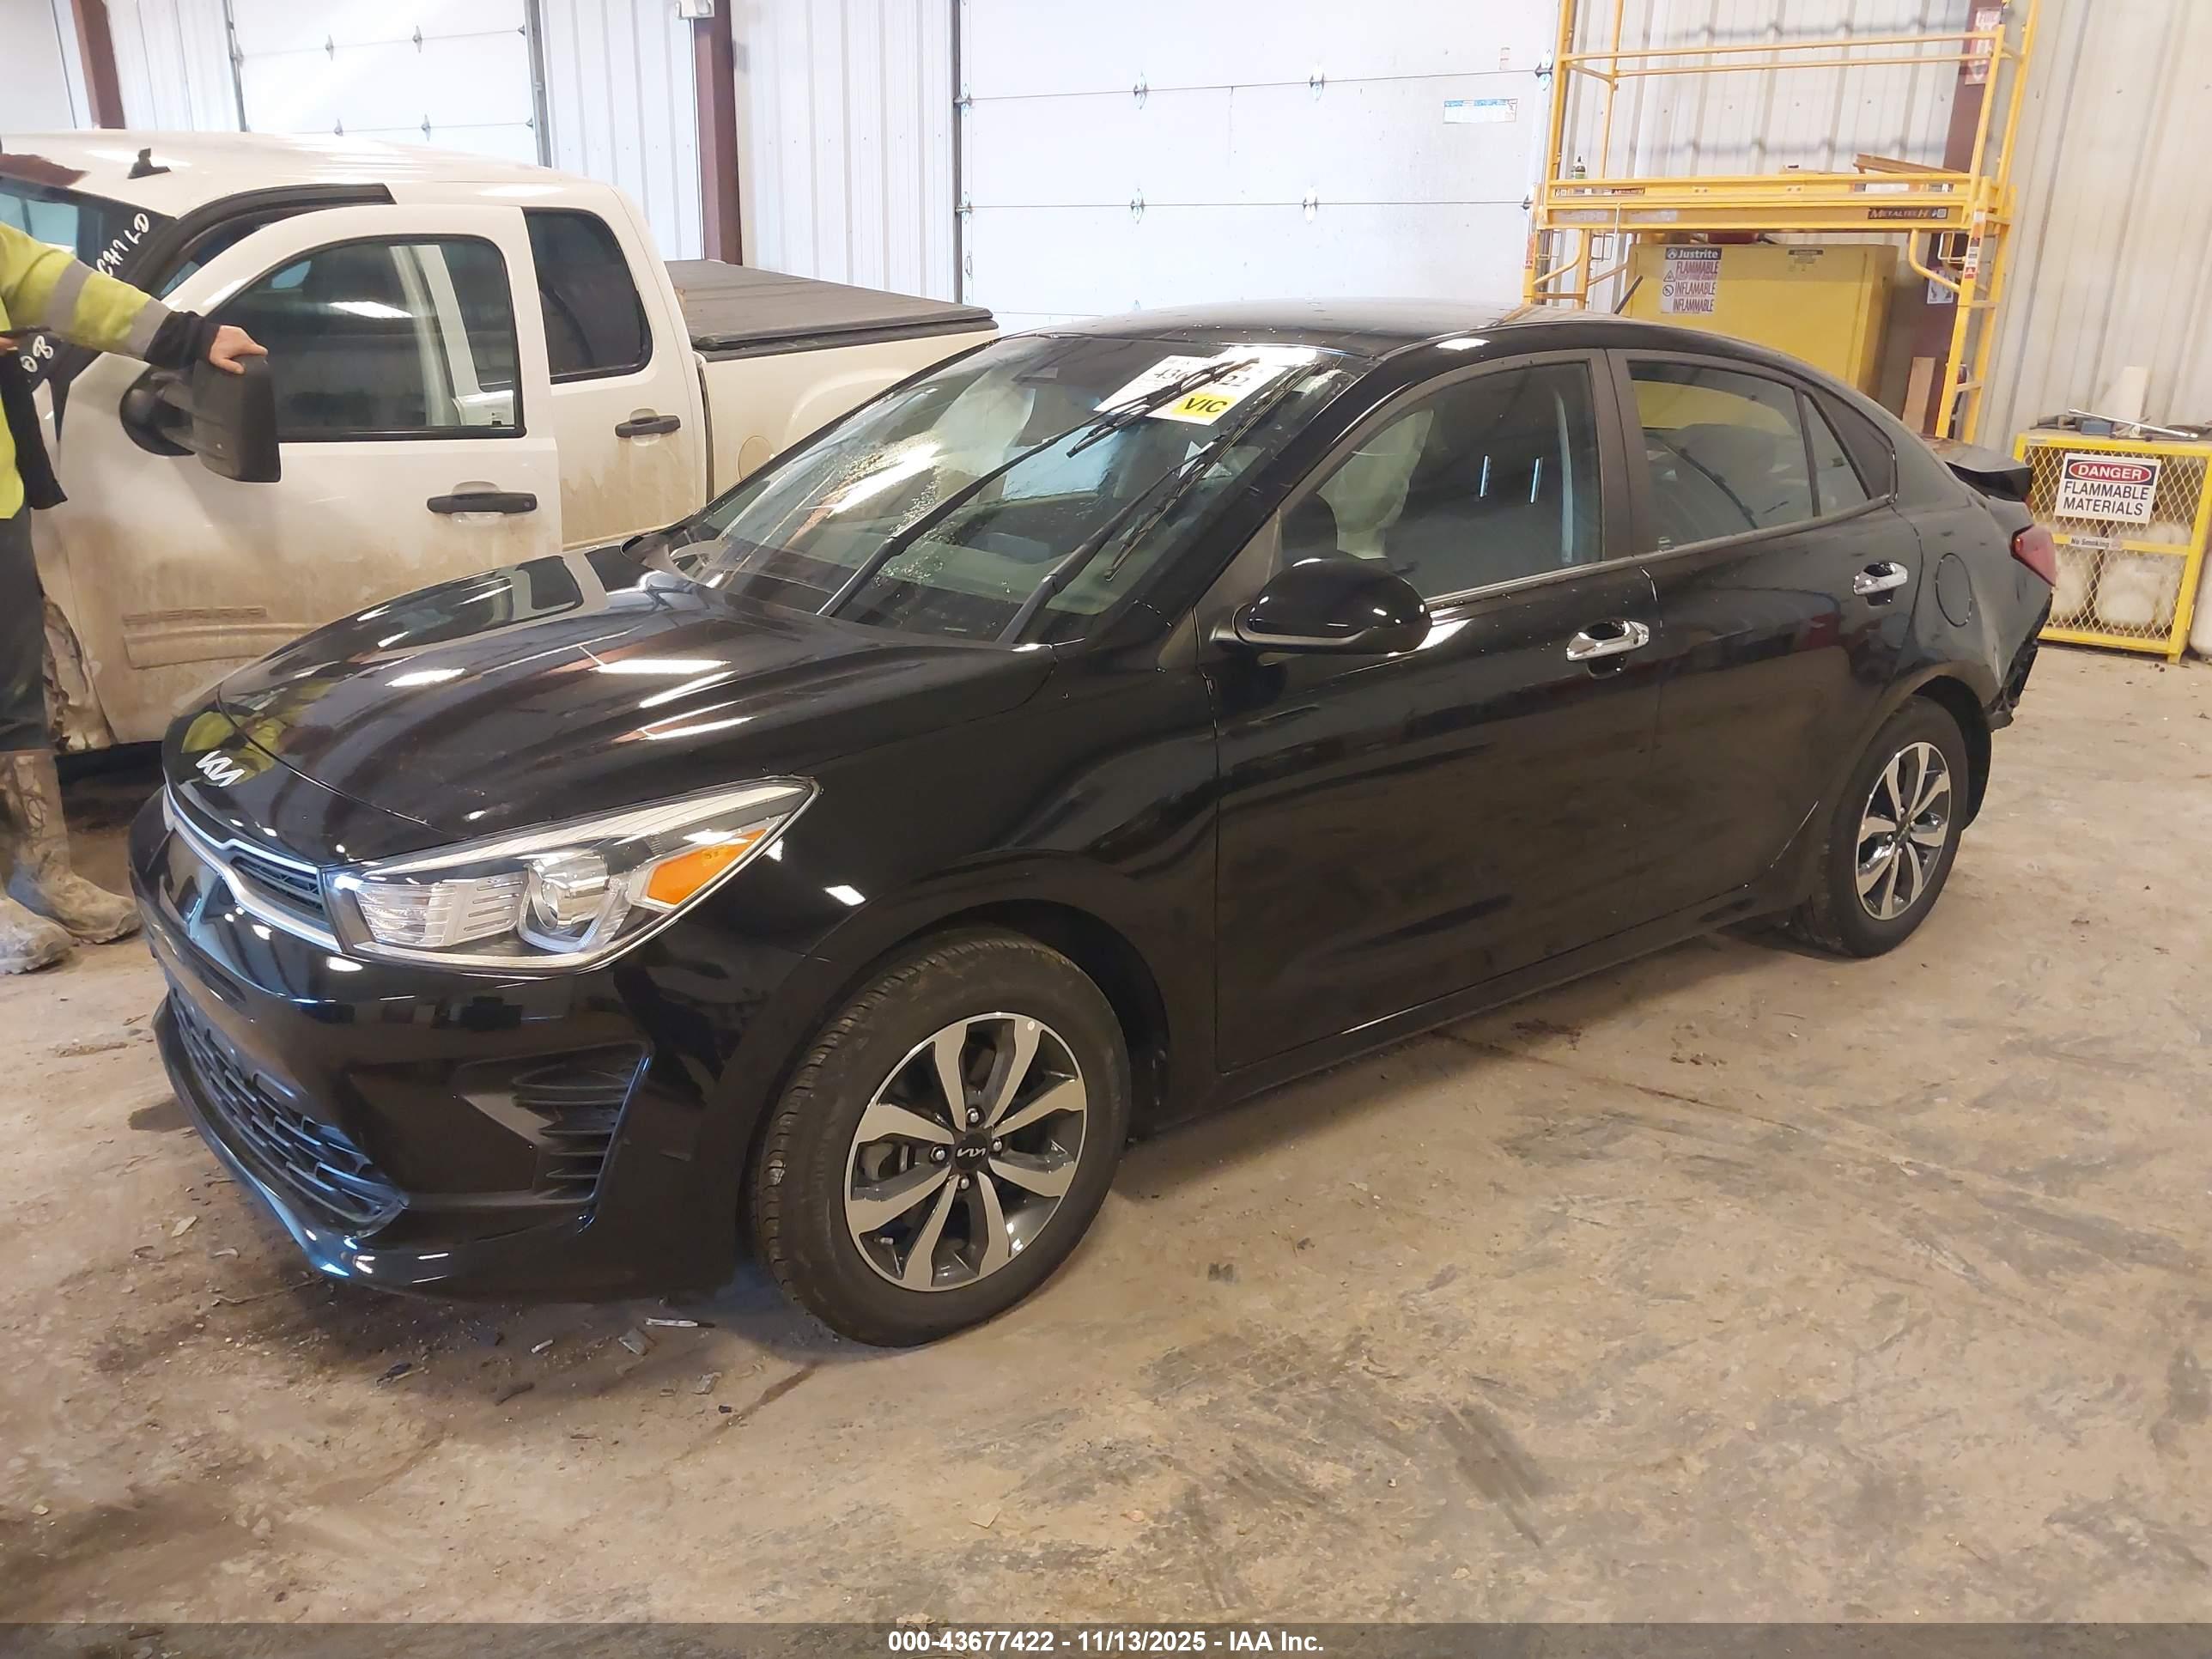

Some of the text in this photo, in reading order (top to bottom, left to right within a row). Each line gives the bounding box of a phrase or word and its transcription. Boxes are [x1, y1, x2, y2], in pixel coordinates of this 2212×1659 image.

[1678, 249, 1718, 258] Justrite
[1676, 261, 1720, 274] FLAMMABLE
[1184, 398, 1228, 413] VIC
[2077, 465, 2142, 480] DANGER
[2063, 481, 2150, 500] FLAMMABLE
[2063, 496, 2144, 516] MATERIALS
